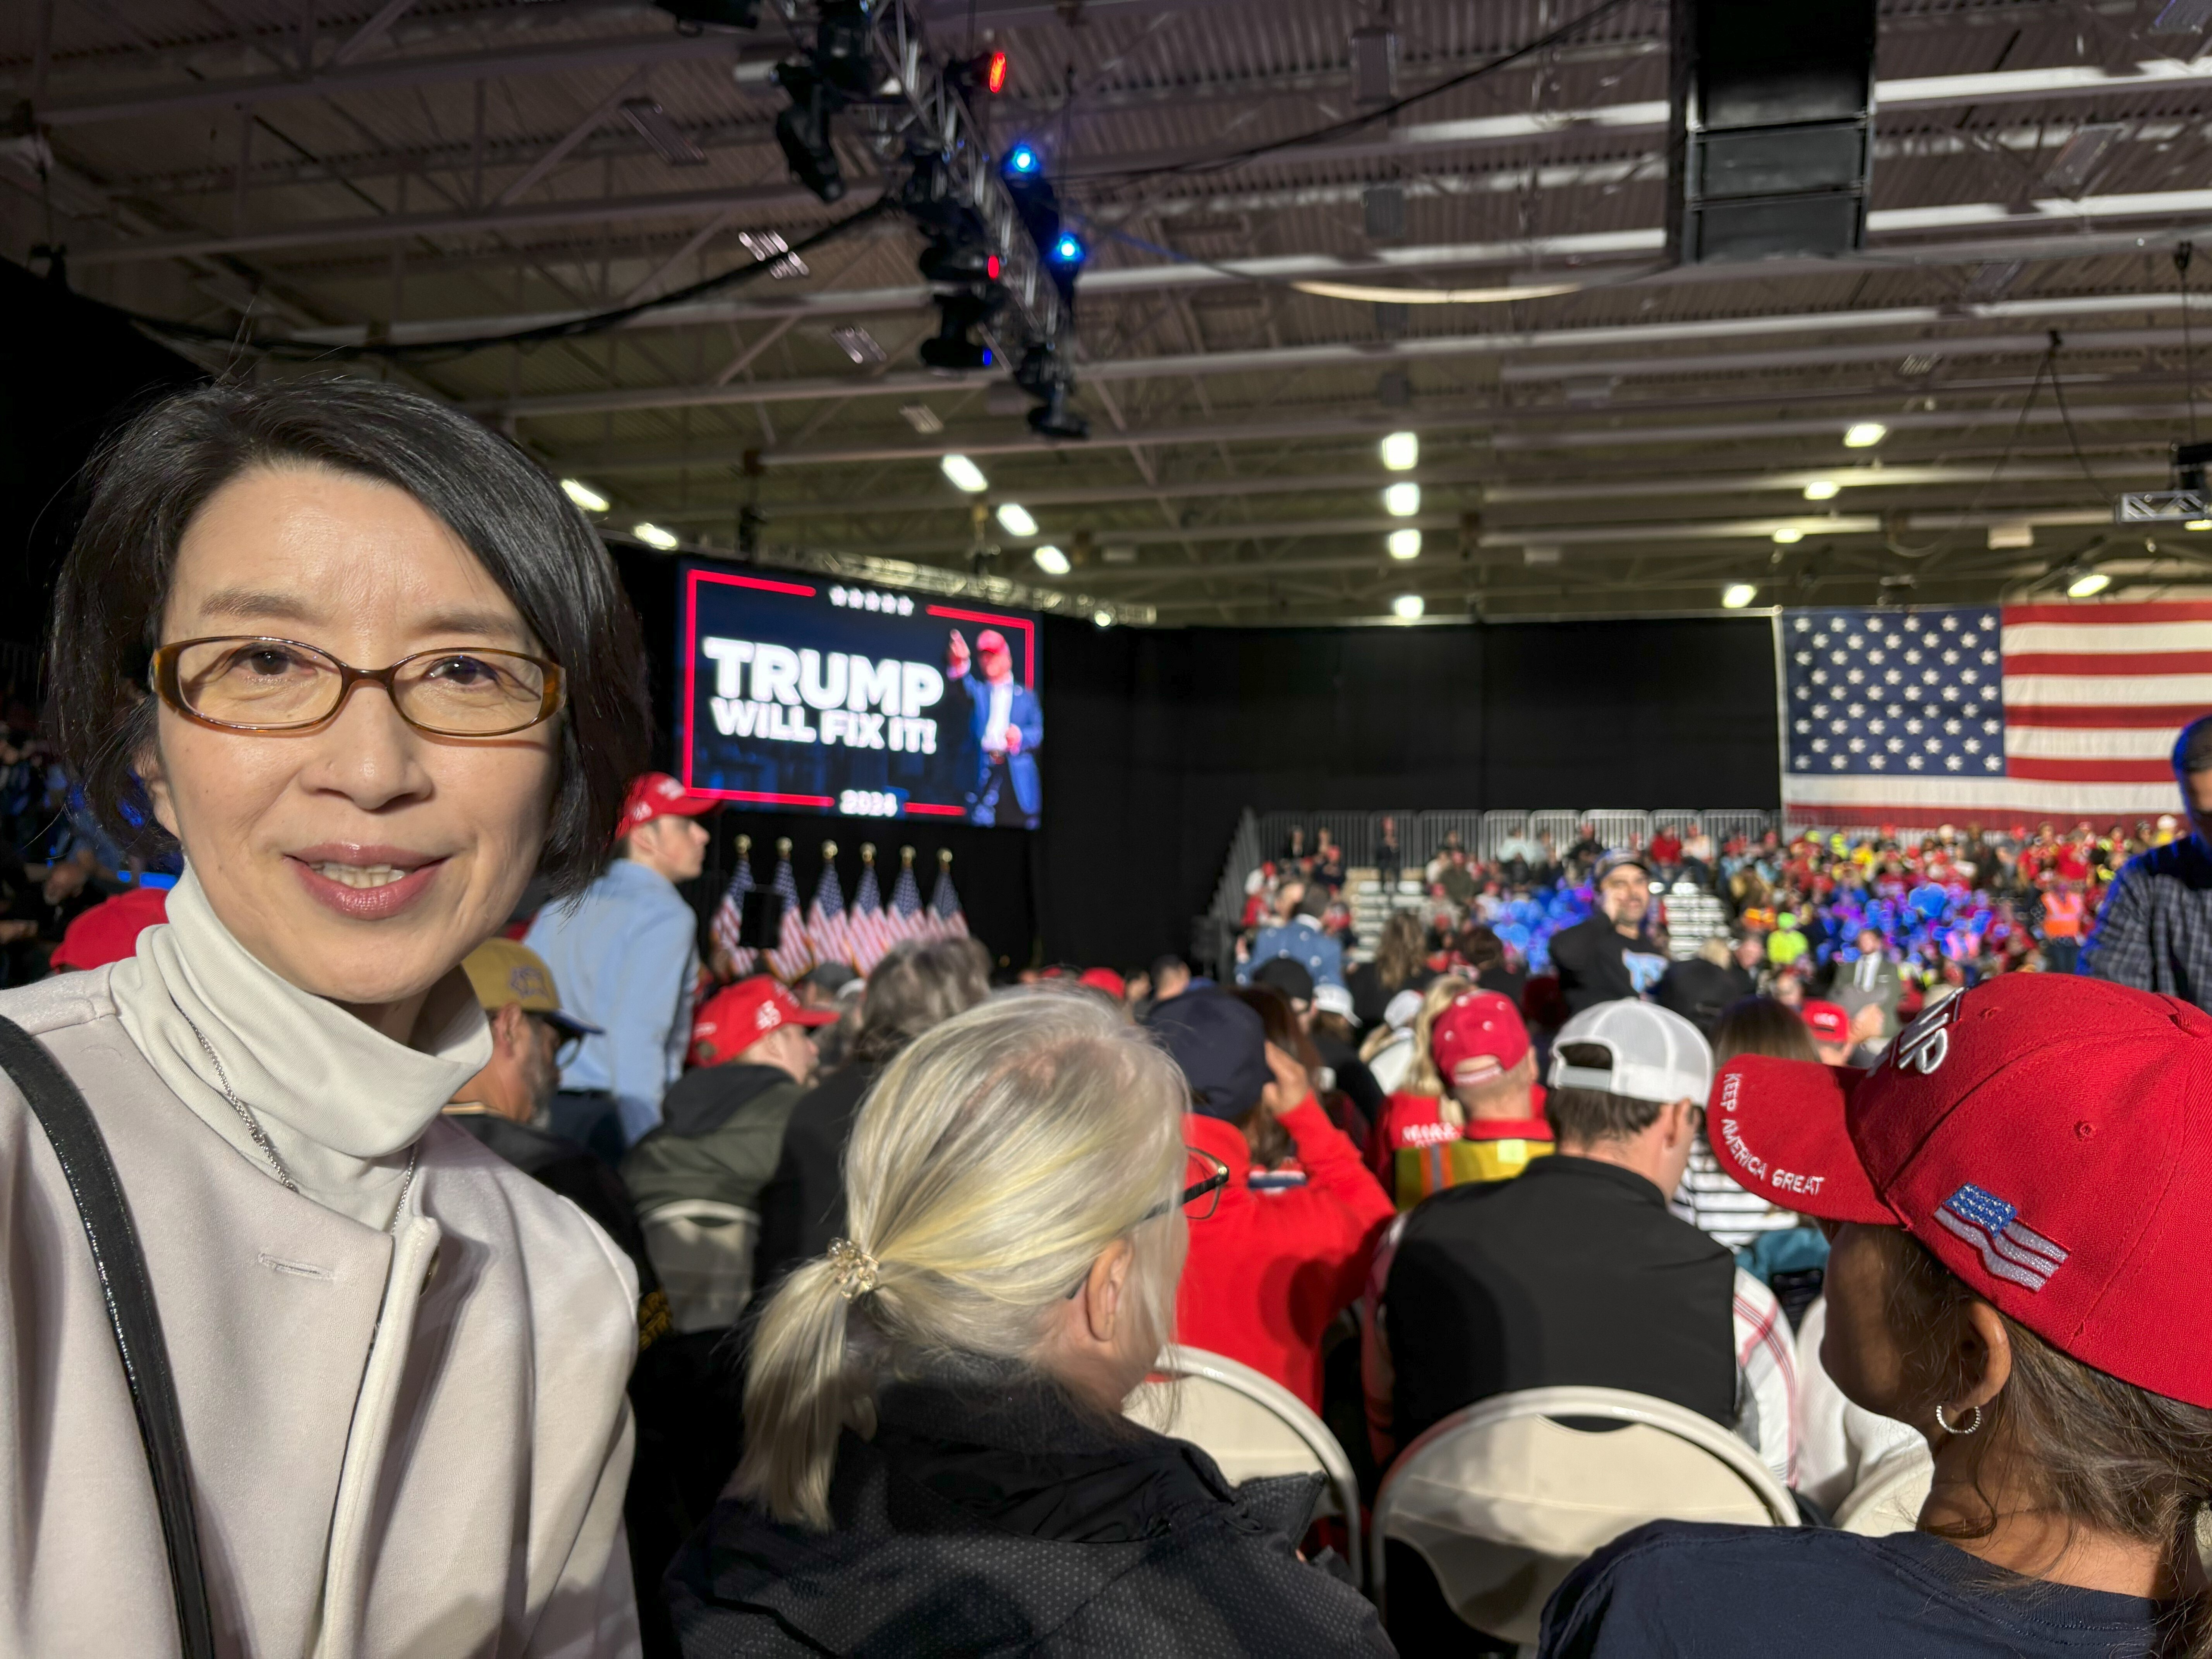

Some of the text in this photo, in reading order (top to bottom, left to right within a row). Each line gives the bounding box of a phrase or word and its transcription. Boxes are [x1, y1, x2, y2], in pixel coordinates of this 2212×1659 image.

[702, 637, 944, 718] TRUMP
[710, 697, 937, 754] WILL FIX IT!
[839, 790, 898, 817] 2024
[1720, 1073, 1825, 1196] KEEP AMERICA GREAT
